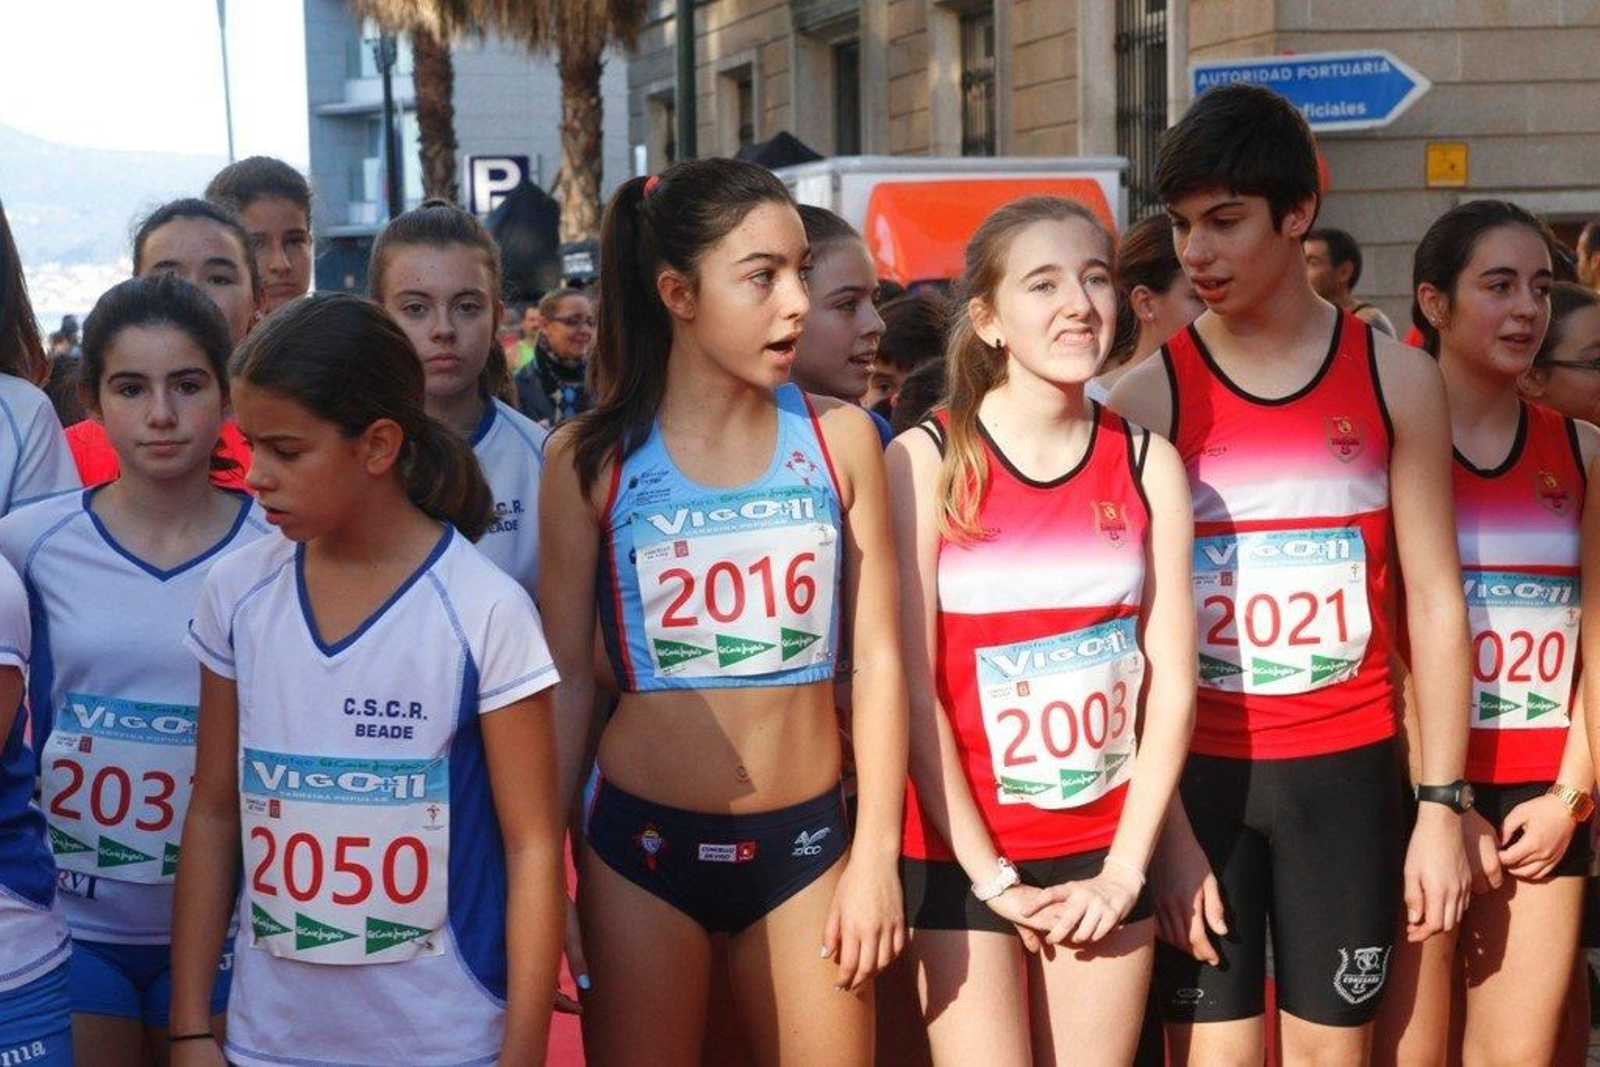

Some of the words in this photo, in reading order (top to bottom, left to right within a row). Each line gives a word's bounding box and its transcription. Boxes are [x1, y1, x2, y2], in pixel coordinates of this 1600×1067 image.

[1198, 68, 1292, 86] AUTORIDAD
[1297, 58, 1391, 80] PORTUARIA
[1301, 100, 1367, 117] ficiales
[474, 158, 521, 213] P
[658, 552, 816, 628] 2016
[1203, 588, 1348, 648] 2021
[1473, 630, 1566, 683] 020
[344, 697, 428, 720] C.S.C.R.
[355, 723, 413, 740] BEADE
[997, 680, 1127, 768] 2003
[50, 758, 197, 832] 203
[250, 825, 429, 905] 2050
[1, 1041, 46, 1067] ma
